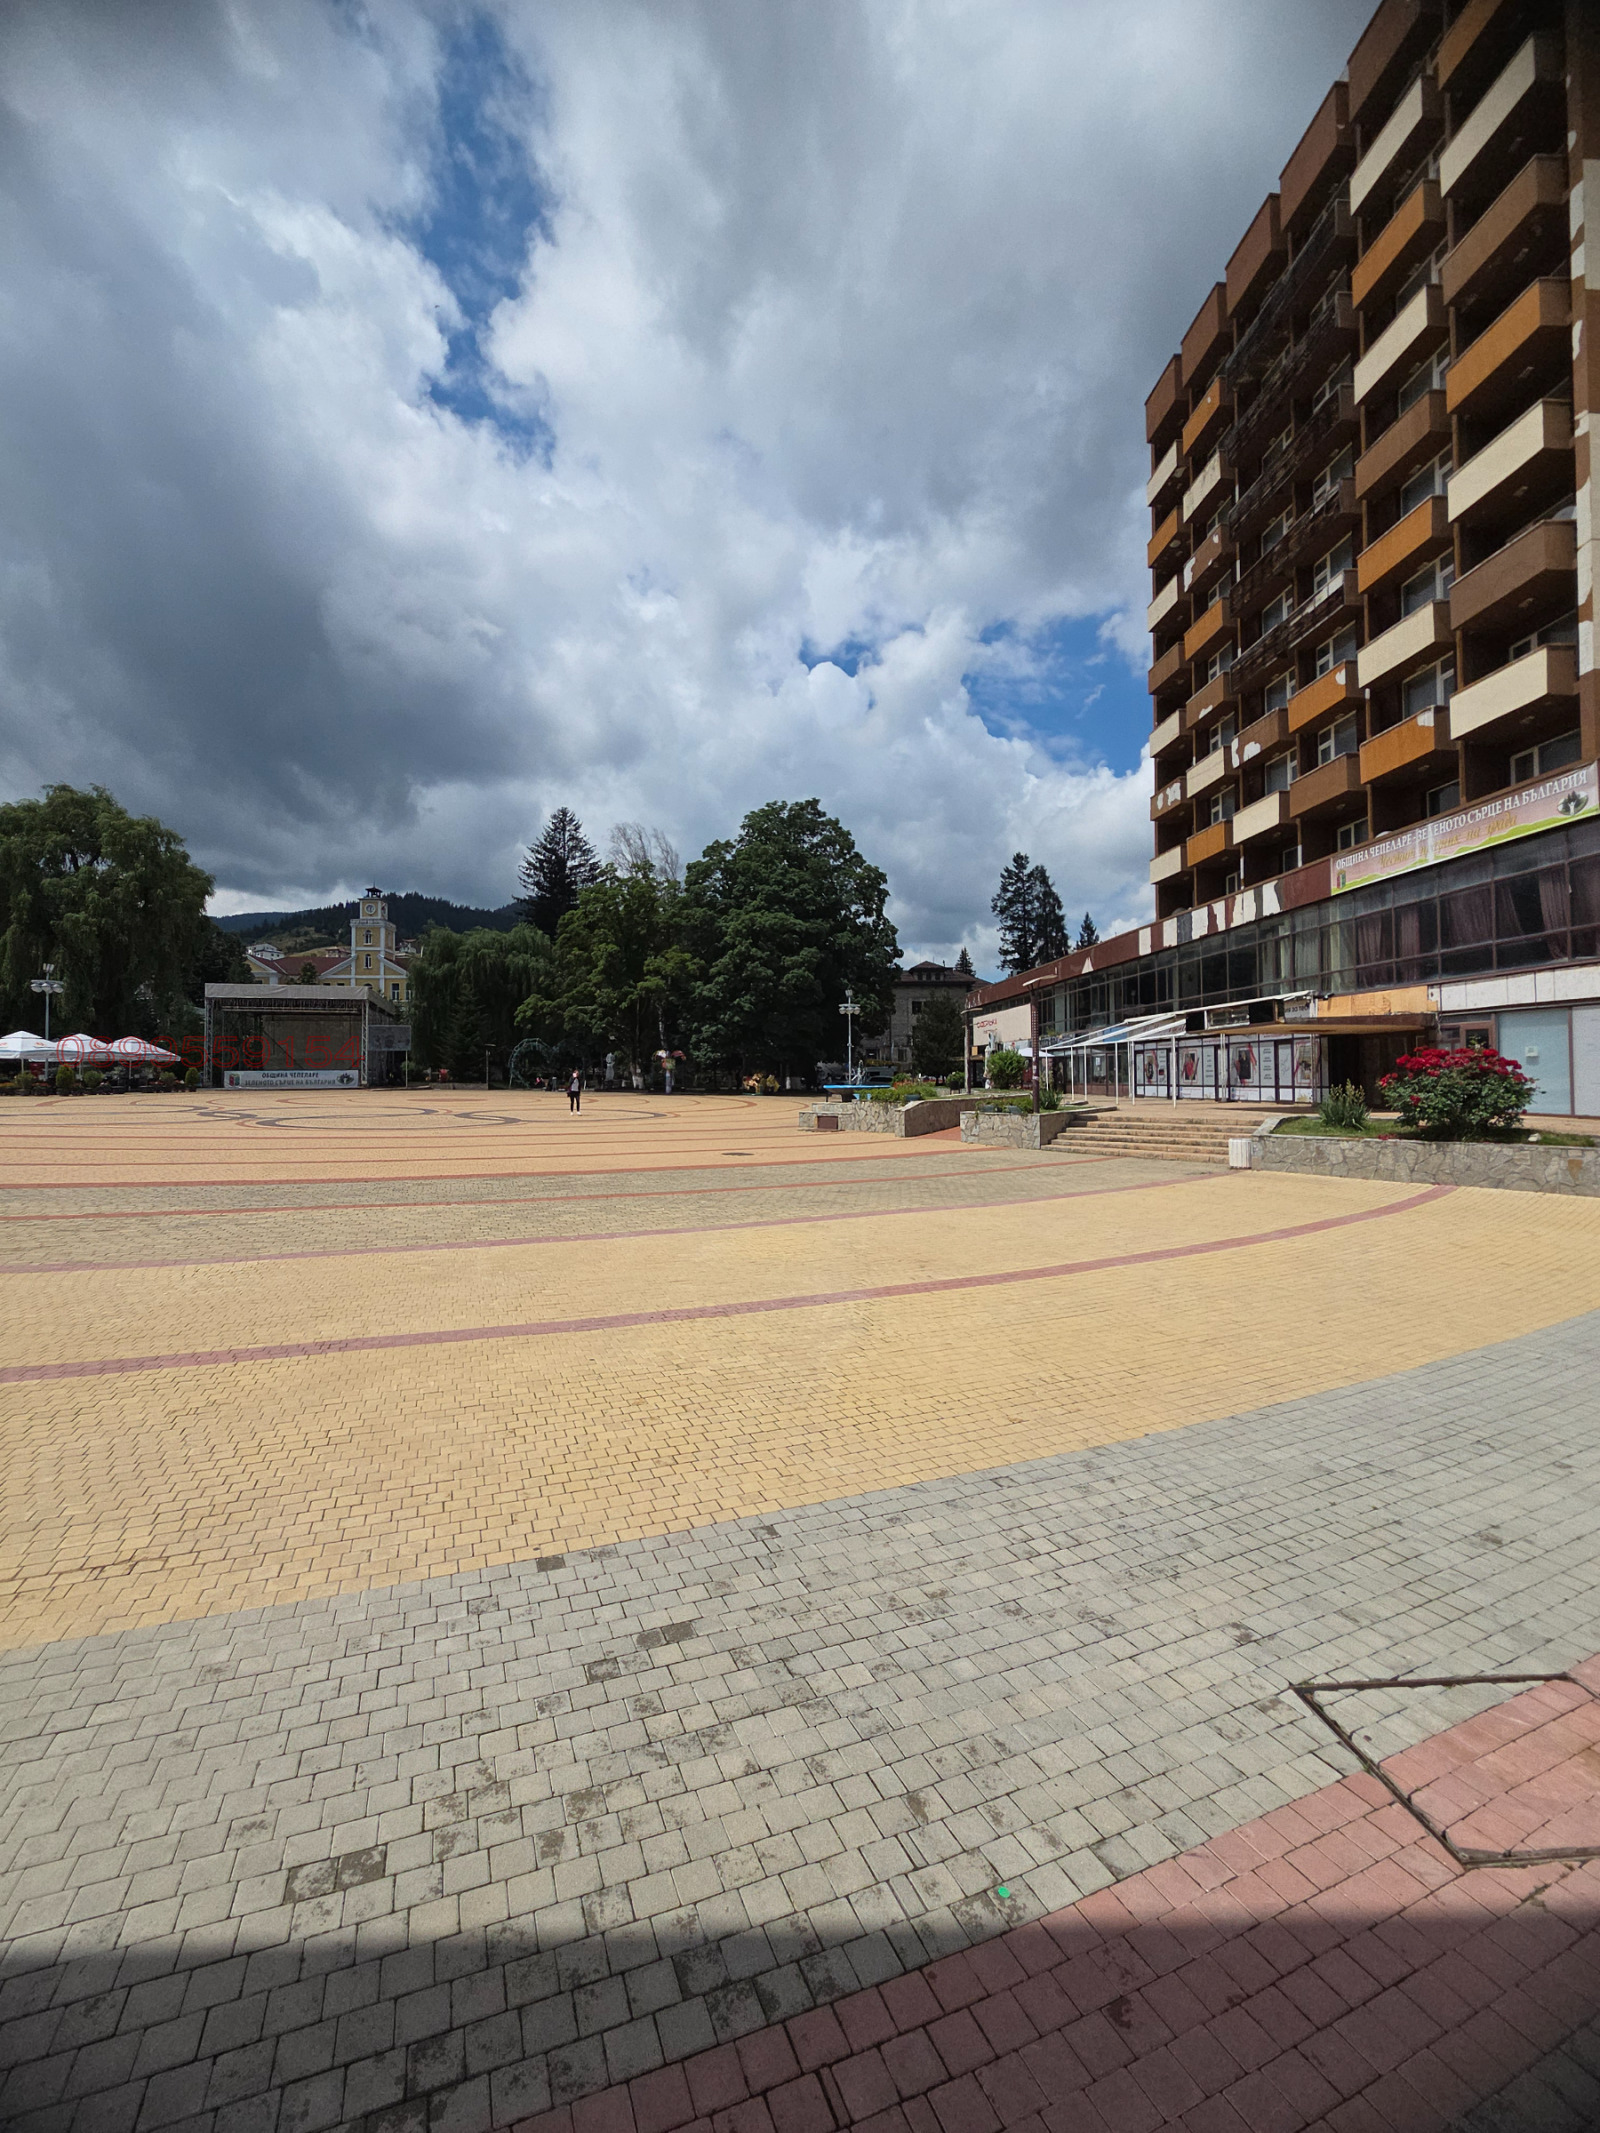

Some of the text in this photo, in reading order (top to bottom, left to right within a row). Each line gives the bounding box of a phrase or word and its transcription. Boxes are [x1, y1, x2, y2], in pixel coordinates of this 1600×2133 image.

[1336, 851, 1369, 869] ОБЩИНА
[1370, 833, 1413, 858] ЧЕПЕЛАРЕ
[1467, 800, 1502, 824] СЪРЦЕ
[1504, 794, 1520, 812] НА
[1522, 770, 1587, 806] БЪЛГАРИЯ
